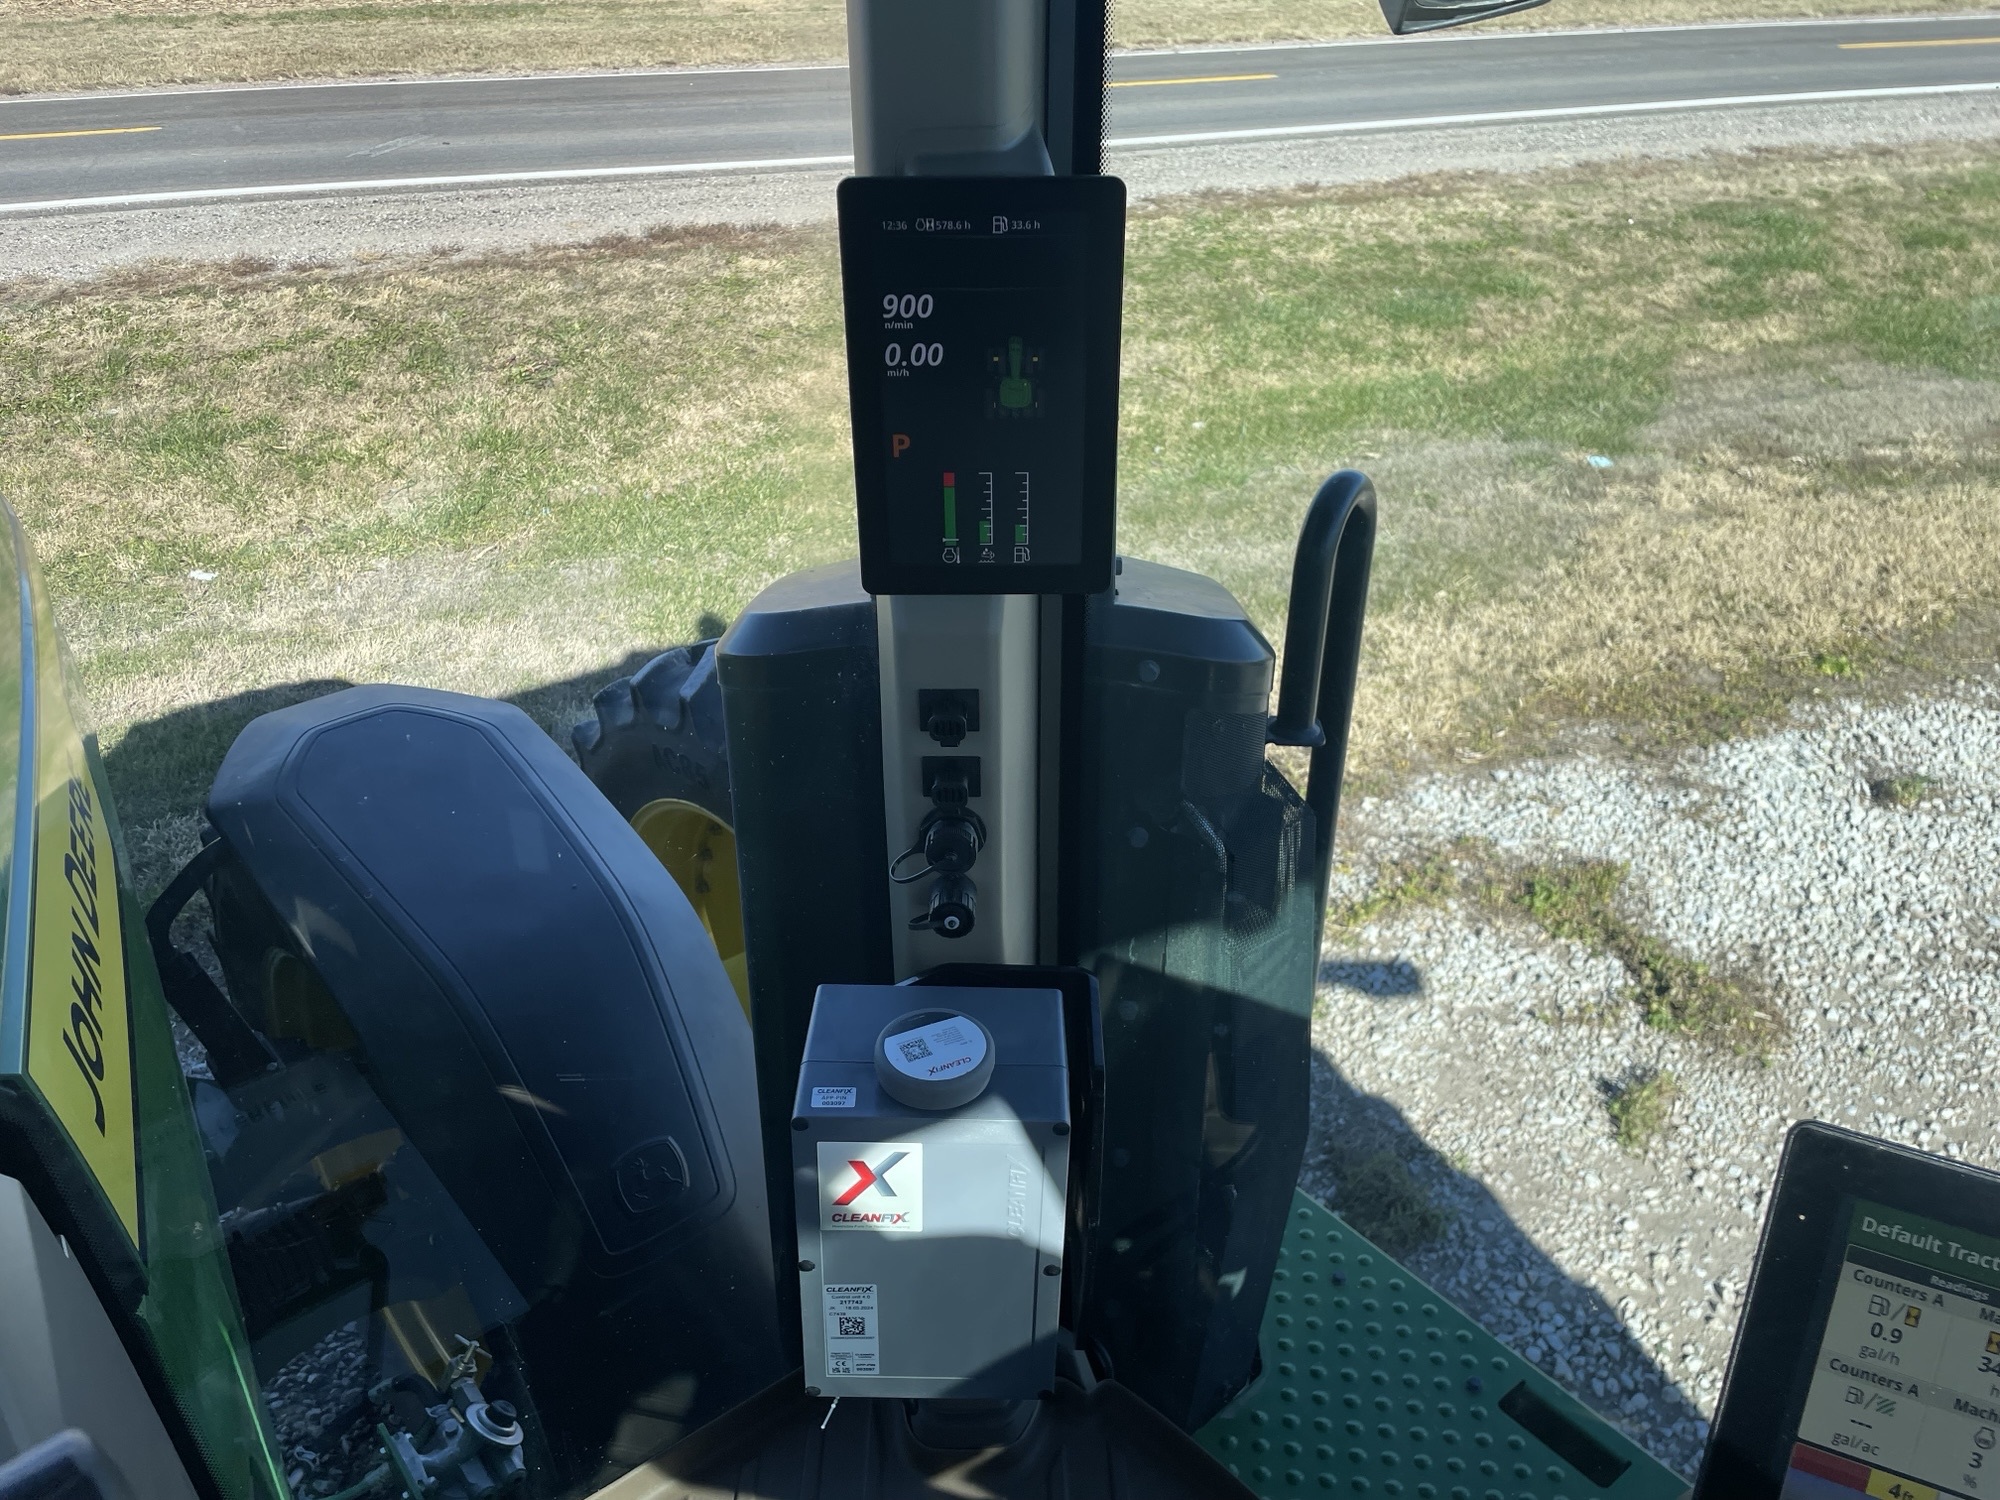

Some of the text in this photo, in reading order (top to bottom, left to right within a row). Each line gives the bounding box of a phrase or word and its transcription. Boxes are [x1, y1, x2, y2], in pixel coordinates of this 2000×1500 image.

[882, 220, 908, 230] 12:36
[935, 220, 971, 230] 578.6 h
[1011, 220, 1041, 230] 33.6 h
[882, 293, 934, 319] 900
[884, 320, 914, 329] n/min
[885, 342, 944, 367] 0.00
[887, 368, 910, 377] mi/h
[892, 433, 911, 458] P
[63, 749, 106, 1138] JOHN DEERE
[831, 1211, 910, 1225] CLEANFIX
[1861, 1215, 2000, 1272] Default Tract
[826, 1285, 873, 1294] CLEANFIX
[1853, 1269, 1945, 1307] Counters A
[1930, 1275, 1990, 1301] Readings
[1870, 1321, 1903, 1344] 0.9
[1858, 1345, 1901, 1366] gal/h
[1829, 1358, 1920, 1398] Counters A
[1952, 1397, 2000, 1425] Mach
[1830, 1431, 1880, 1457] gal/ac
[1968, 1451, 1984, 1469] 3
[1888, 1483, 1902, 1499] 4
[1962, 1473, 1978, 1490] %
